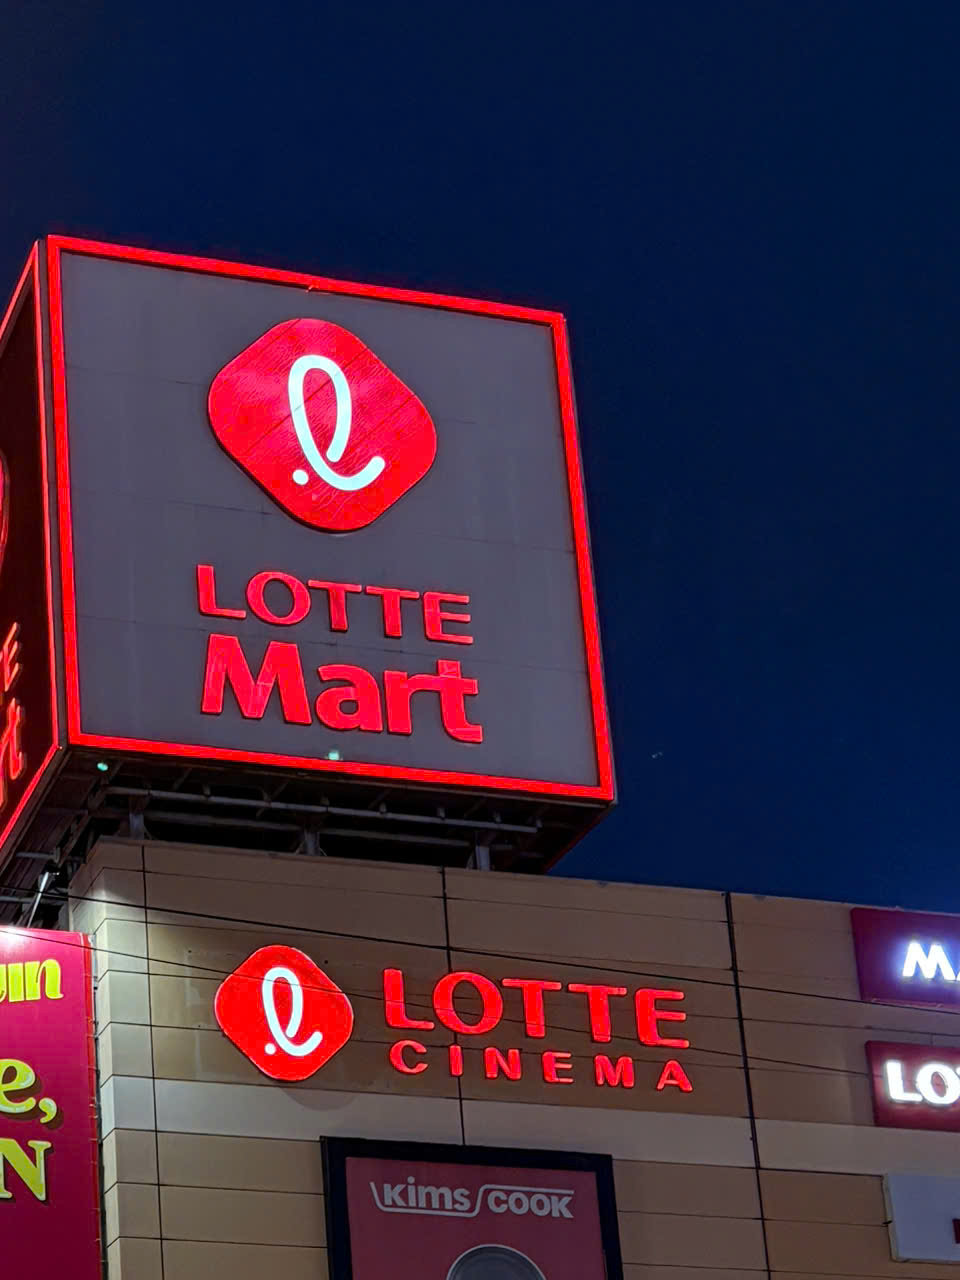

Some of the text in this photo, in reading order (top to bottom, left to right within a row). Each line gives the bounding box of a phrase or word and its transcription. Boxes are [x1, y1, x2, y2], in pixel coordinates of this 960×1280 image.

[196, 564, 474, 646] LOTTE
[200, 633, 483, 744] Mart
[382, 967, 690, 1049] LOTTE
[388, 1039, 693, 1093] CINEMA
[886, 1060, 960, 1104] LO
